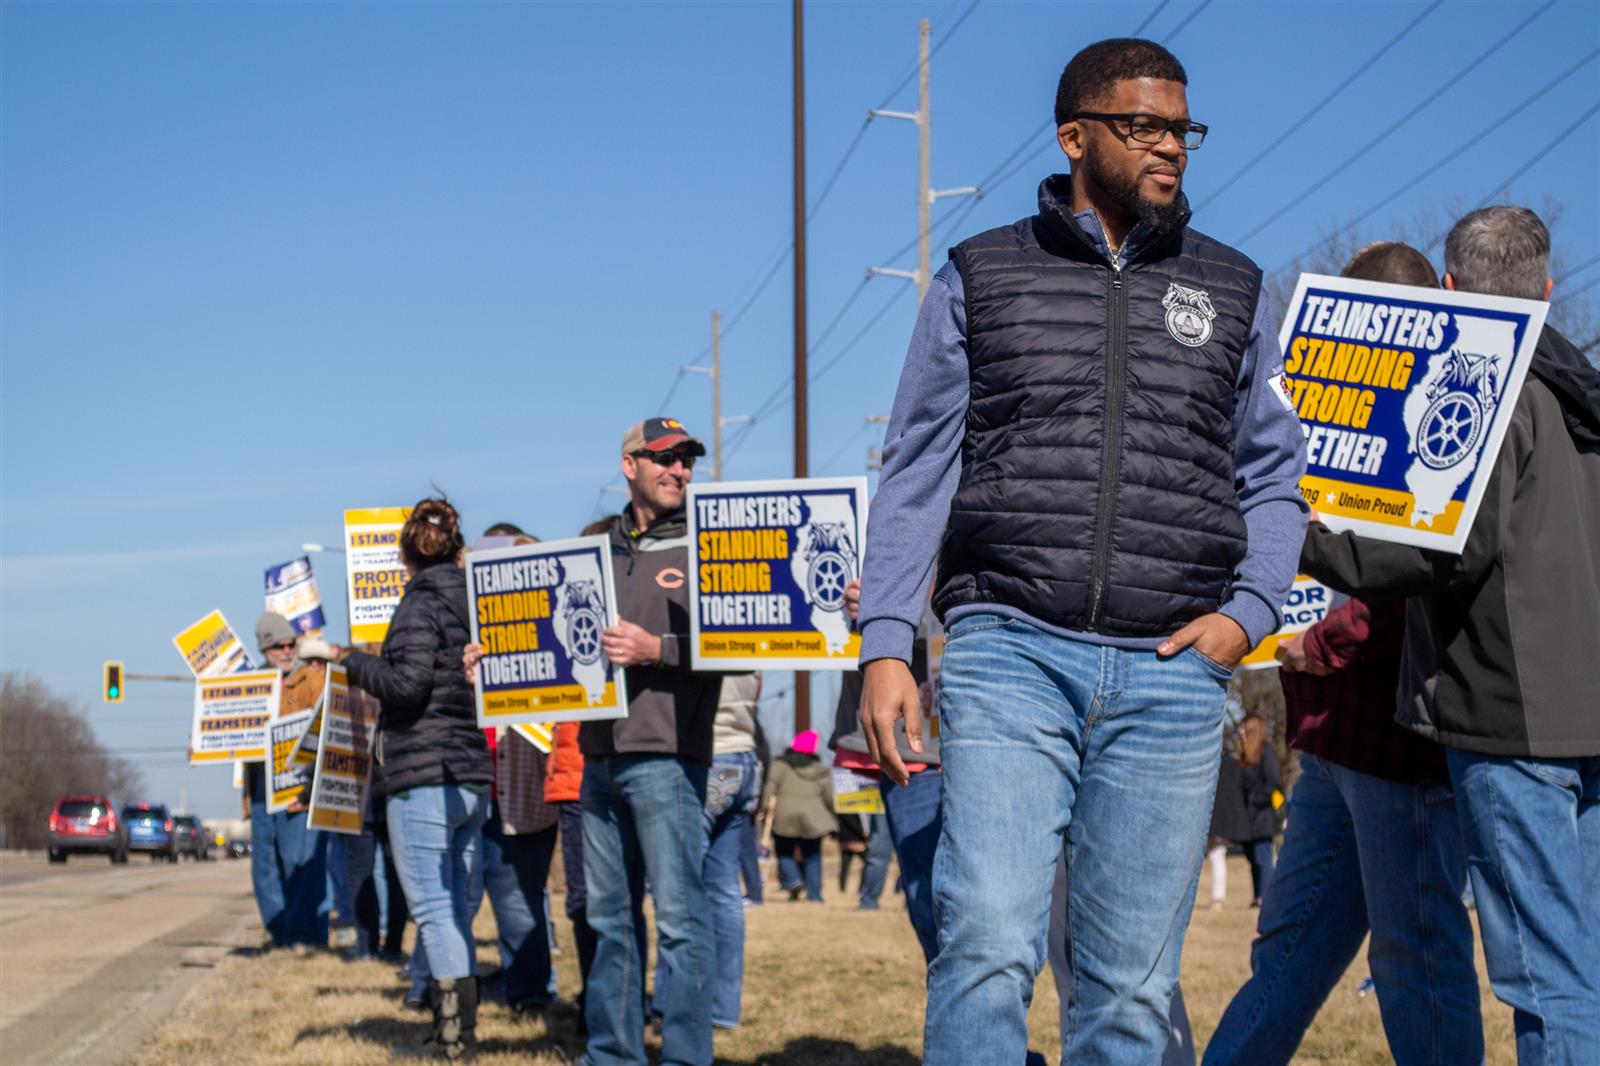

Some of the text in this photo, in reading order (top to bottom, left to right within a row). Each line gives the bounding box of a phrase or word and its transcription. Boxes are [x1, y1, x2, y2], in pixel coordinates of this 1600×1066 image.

[1300, 295, 1450, 351] TEAMSTERS
[1285, 336, 1416, 391] STANDING
[1301, 423, 1388, 476] ETHER
[697, 495, 802, 529] TEAMSTERS
[1338, 492, 1371, 511] Union
[1372, 498, 1408, 517] Proud
[358, 533, 397, 545] STAND
[699, 528, 788, 561] STANDING
[474, 556, 559, 595] TEAMSTERS
[699, 562, 771, 593] STRONG
[477, 589, 551, 625] STANDING
[700, 594, 792, 625] TOGETHER
[1286, 587, 1325, 606] OR
[1283, 608, 1326, 625] ACT
[480, 622, 539, 656] STRONG
[704, 639, 821, 653] Union Strong Union Proud
[481, 651, 557, 686] TOGETHER
